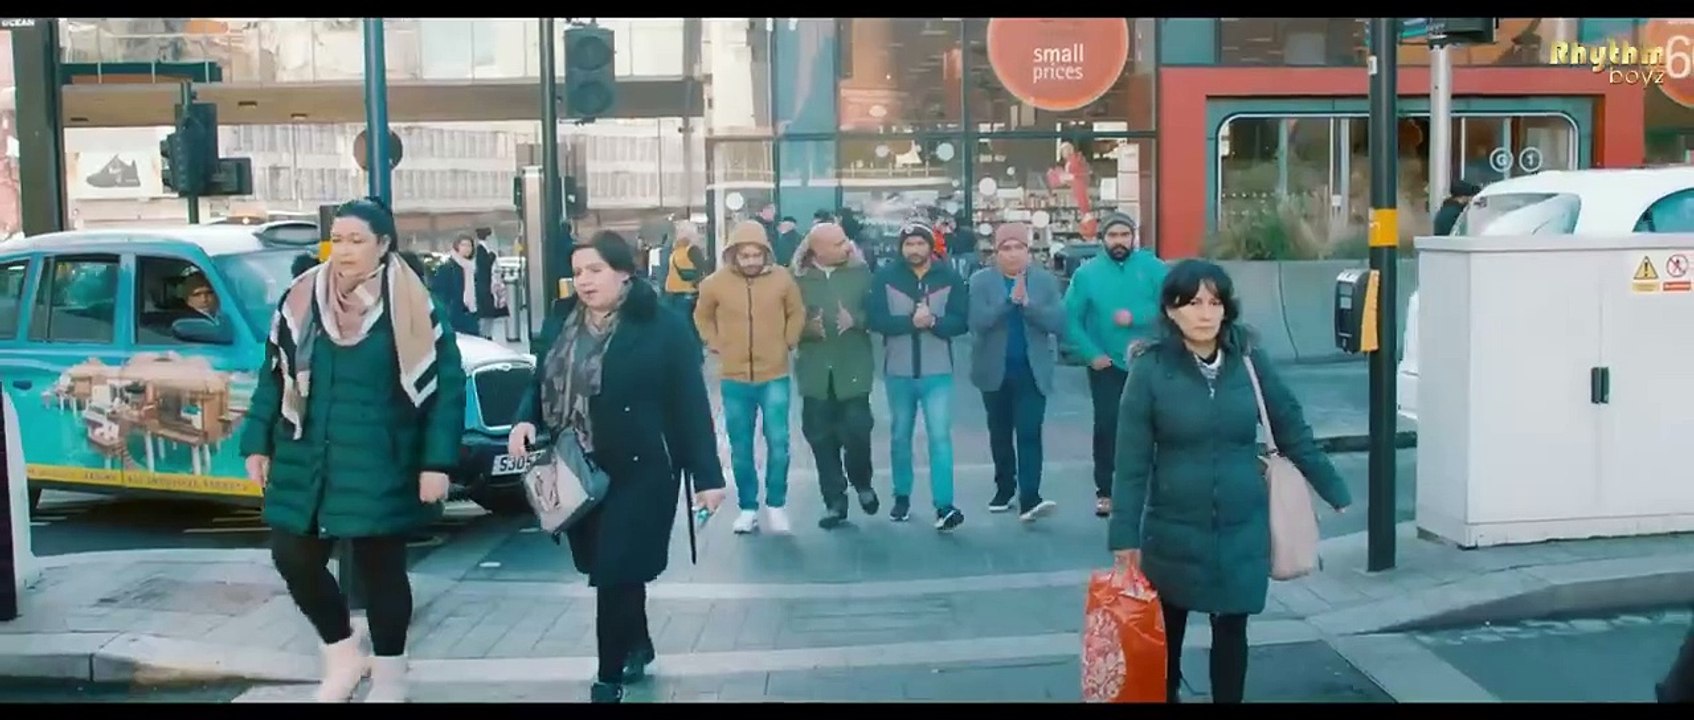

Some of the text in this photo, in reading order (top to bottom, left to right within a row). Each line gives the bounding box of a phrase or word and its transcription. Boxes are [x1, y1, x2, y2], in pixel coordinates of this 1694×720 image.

[1033, 43, 1084, 63] small
[1665, 35, 1694, 79] 6
[1033, 62, 1084, 84] prices
